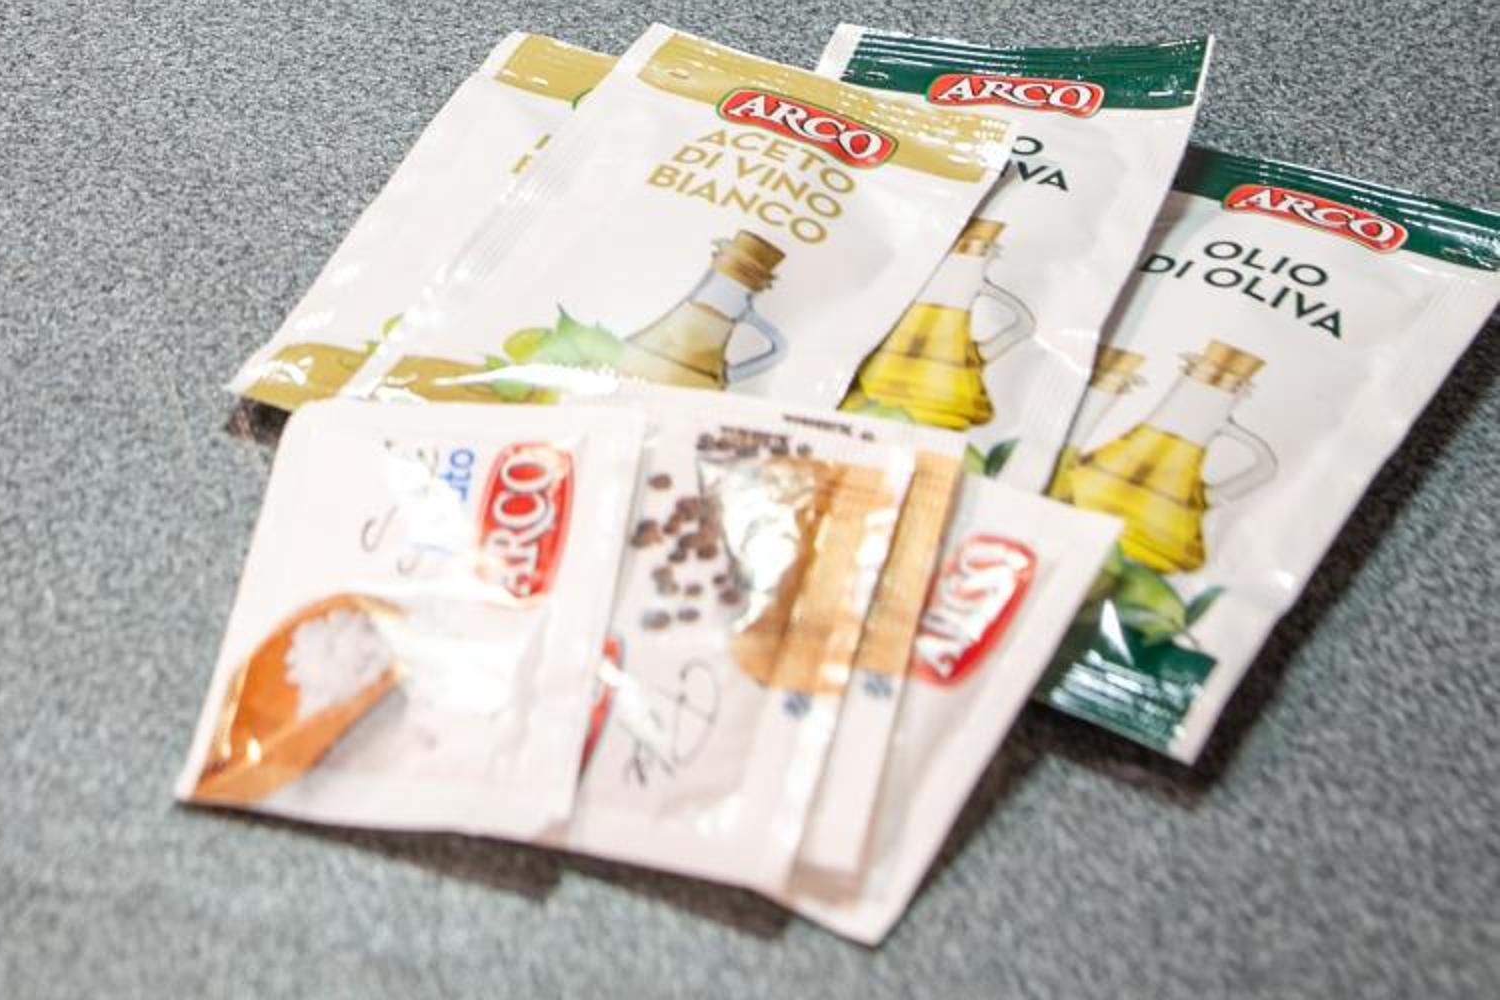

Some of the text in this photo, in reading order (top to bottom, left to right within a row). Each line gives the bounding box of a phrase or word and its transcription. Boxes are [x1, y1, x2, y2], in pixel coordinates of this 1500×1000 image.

[939, 78, 1093, 109] ARCO
[726, 95, 883, 159] ARCO
[671, 144, 843, 220] DI VINO
[696, 127, 856, 195] ACETO
[646, 164, 828, 245] BIANCO
[1233, 189, 1395, 243] ARCO
[1140, 255, 1343, 339] DI OLIVA
[1204, 241, 1329, 288] OLIO
